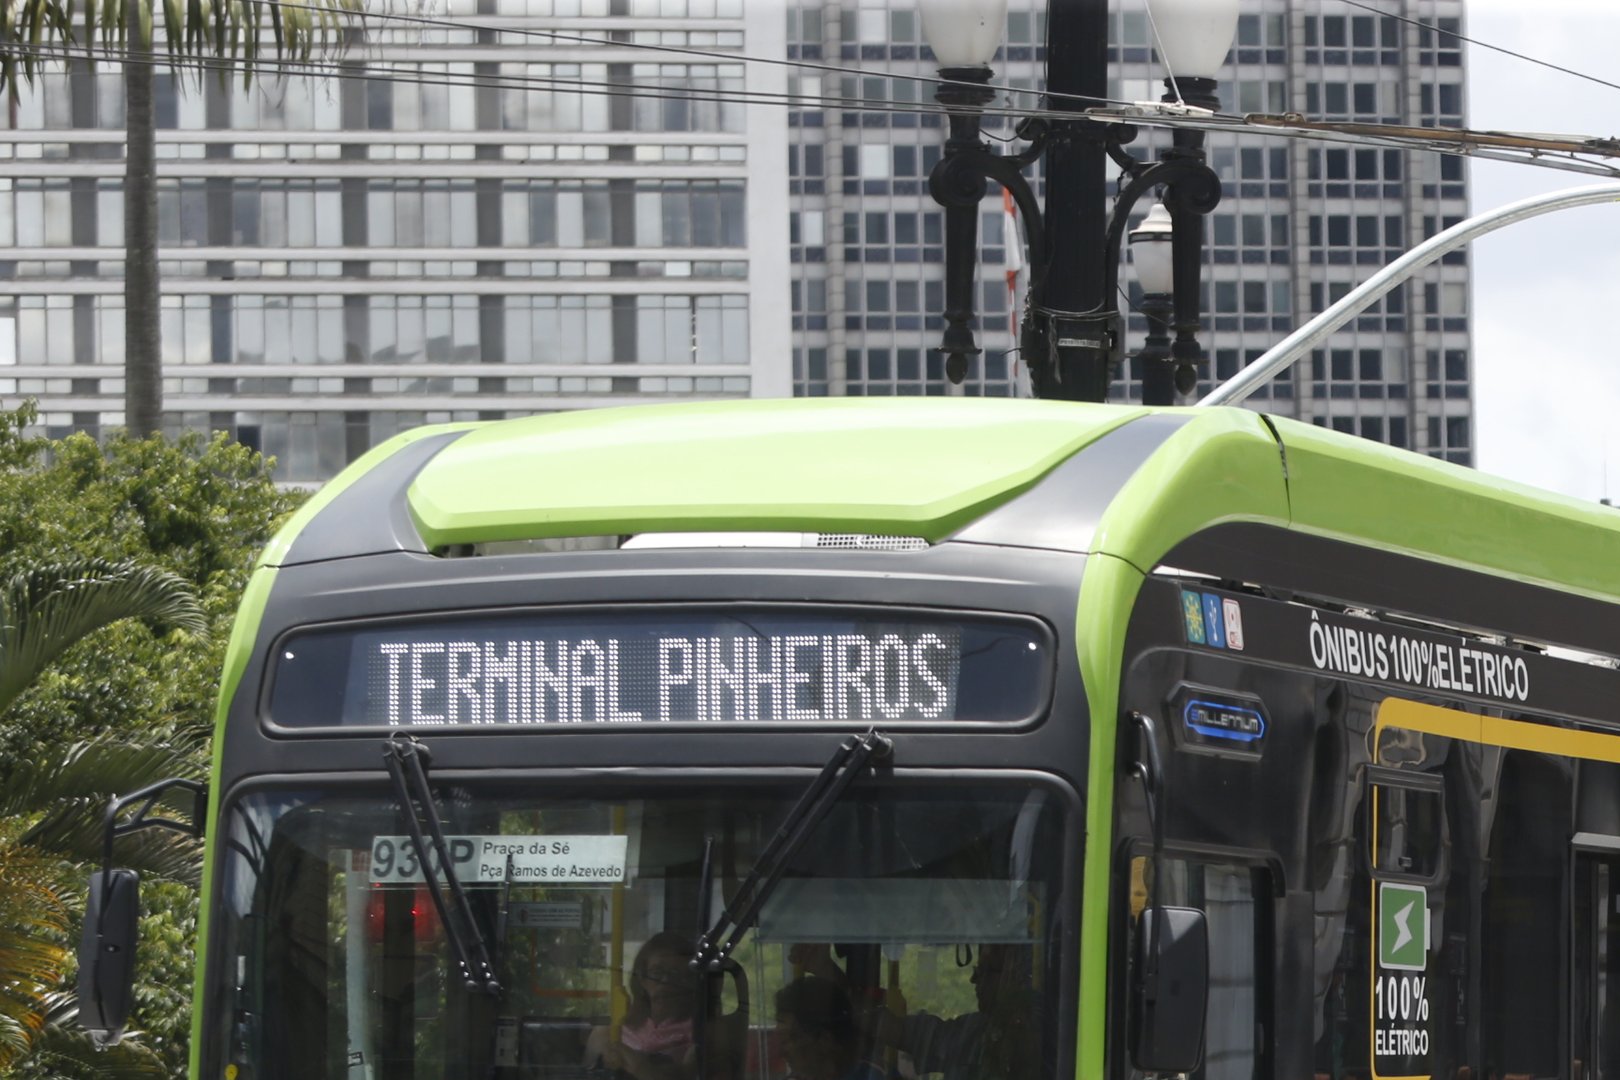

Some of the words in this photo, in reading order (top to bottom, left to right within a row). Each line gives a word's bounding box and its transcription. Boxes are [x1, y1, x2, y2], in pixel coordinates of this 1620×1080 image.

[1310, 610, 1389, 679] ÔNIBUS
[1390, 635, 1438, 688] 100%
[1436, 637, 1528, 700] ELÉTRICO
[380, 639, 641, 725] TERMINAL
[659, 633, 947, 721] PINHEIROS
[483, 842, 524, 856] Praça
[529, 842, 546, 855] da
[552, 842, 570, 855] Sé
[480, 864, 503, 879] Pça
[551, 864, 566, 876] de
[569, 865, 622, 878] Azevedo
[1375, 975, 1429, 1021] 100%
[1375, 1022, 1429, 1056] ELÉTRICO
